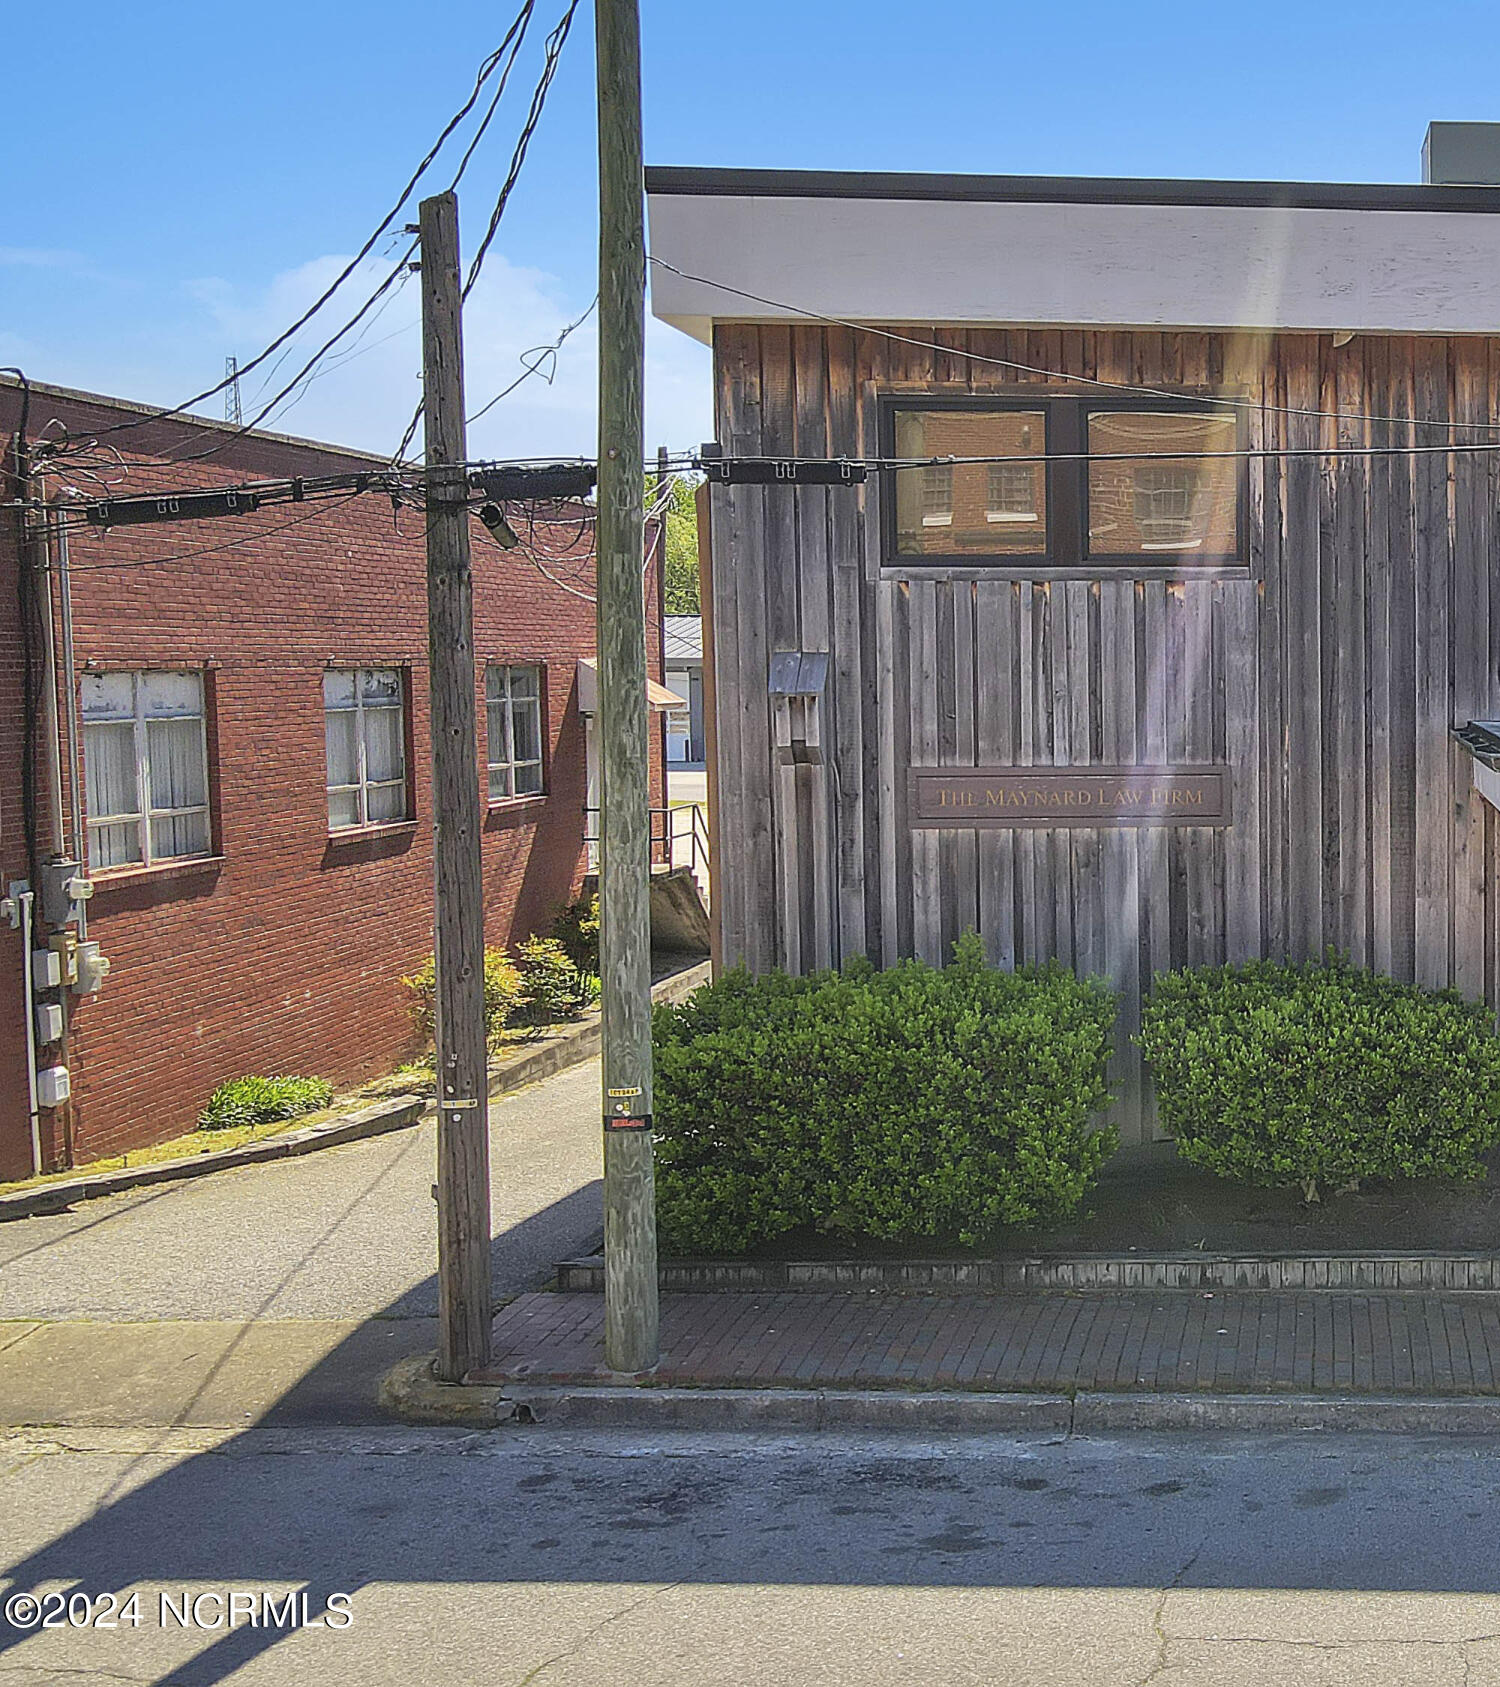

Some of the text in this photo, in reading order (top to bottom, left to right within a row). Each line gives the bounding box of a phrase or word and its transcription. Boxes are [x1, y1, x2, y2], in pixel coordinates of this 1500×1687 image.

[938, 788, 1203, 807] THE MAYNARD LAW FIRM
